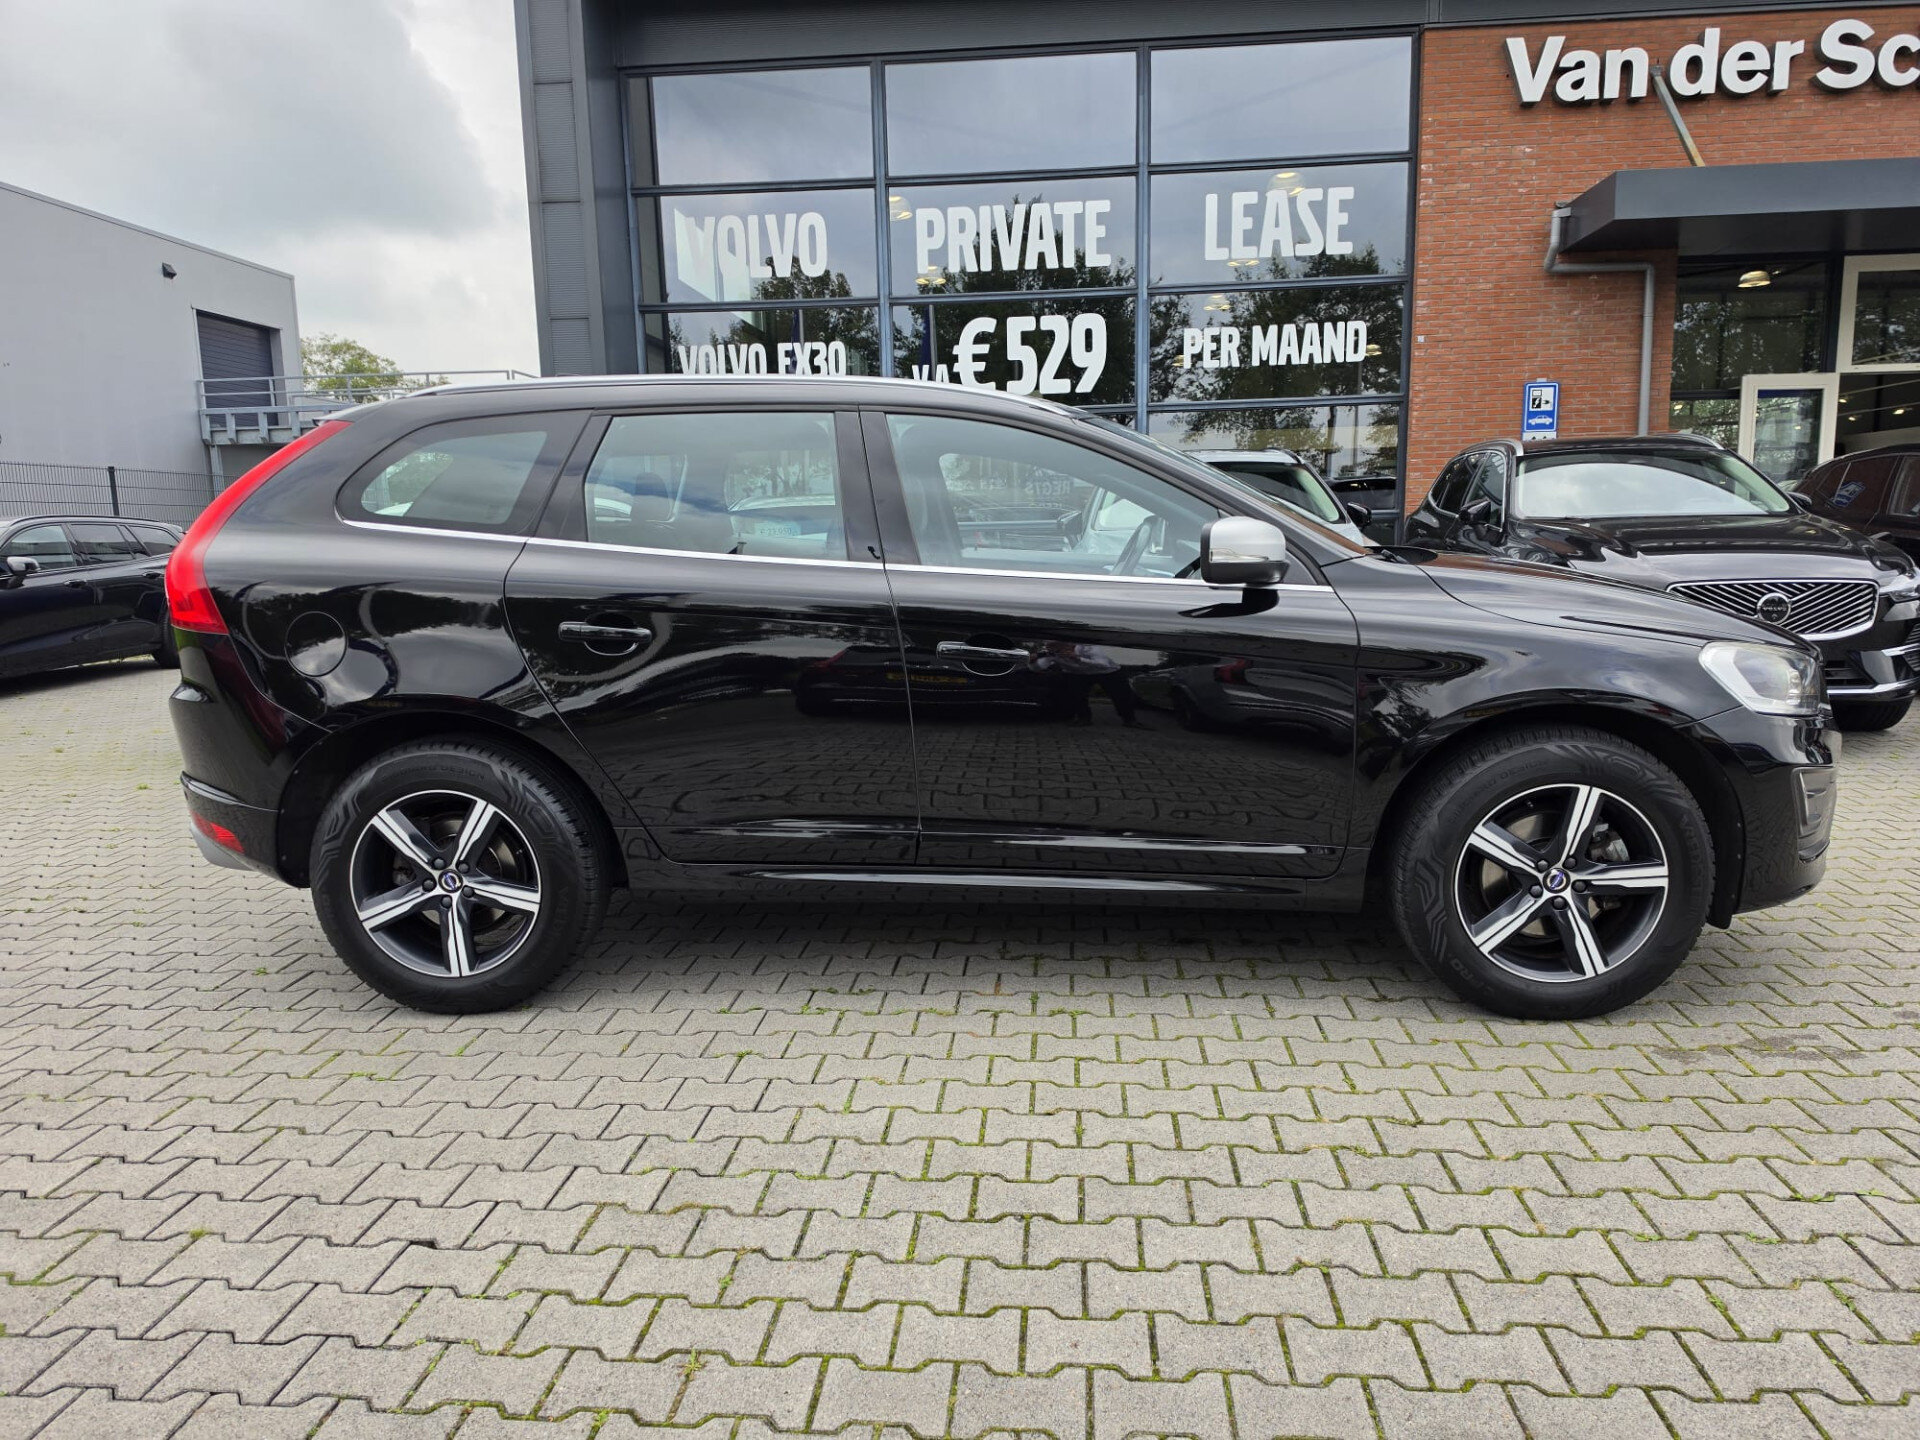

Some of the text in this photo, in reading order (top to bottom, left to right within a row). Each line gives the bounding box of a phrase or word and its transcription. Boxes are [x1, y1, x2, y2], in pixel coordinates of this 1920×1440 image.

[1505, 18, 1920, 103] Van der Sc
[683, 186, 1356, 279] VOLVO PRIVATE LEASE
[1183, 326, 1240, 370] PER
[1250, 320, 1368, 368] MAAND
